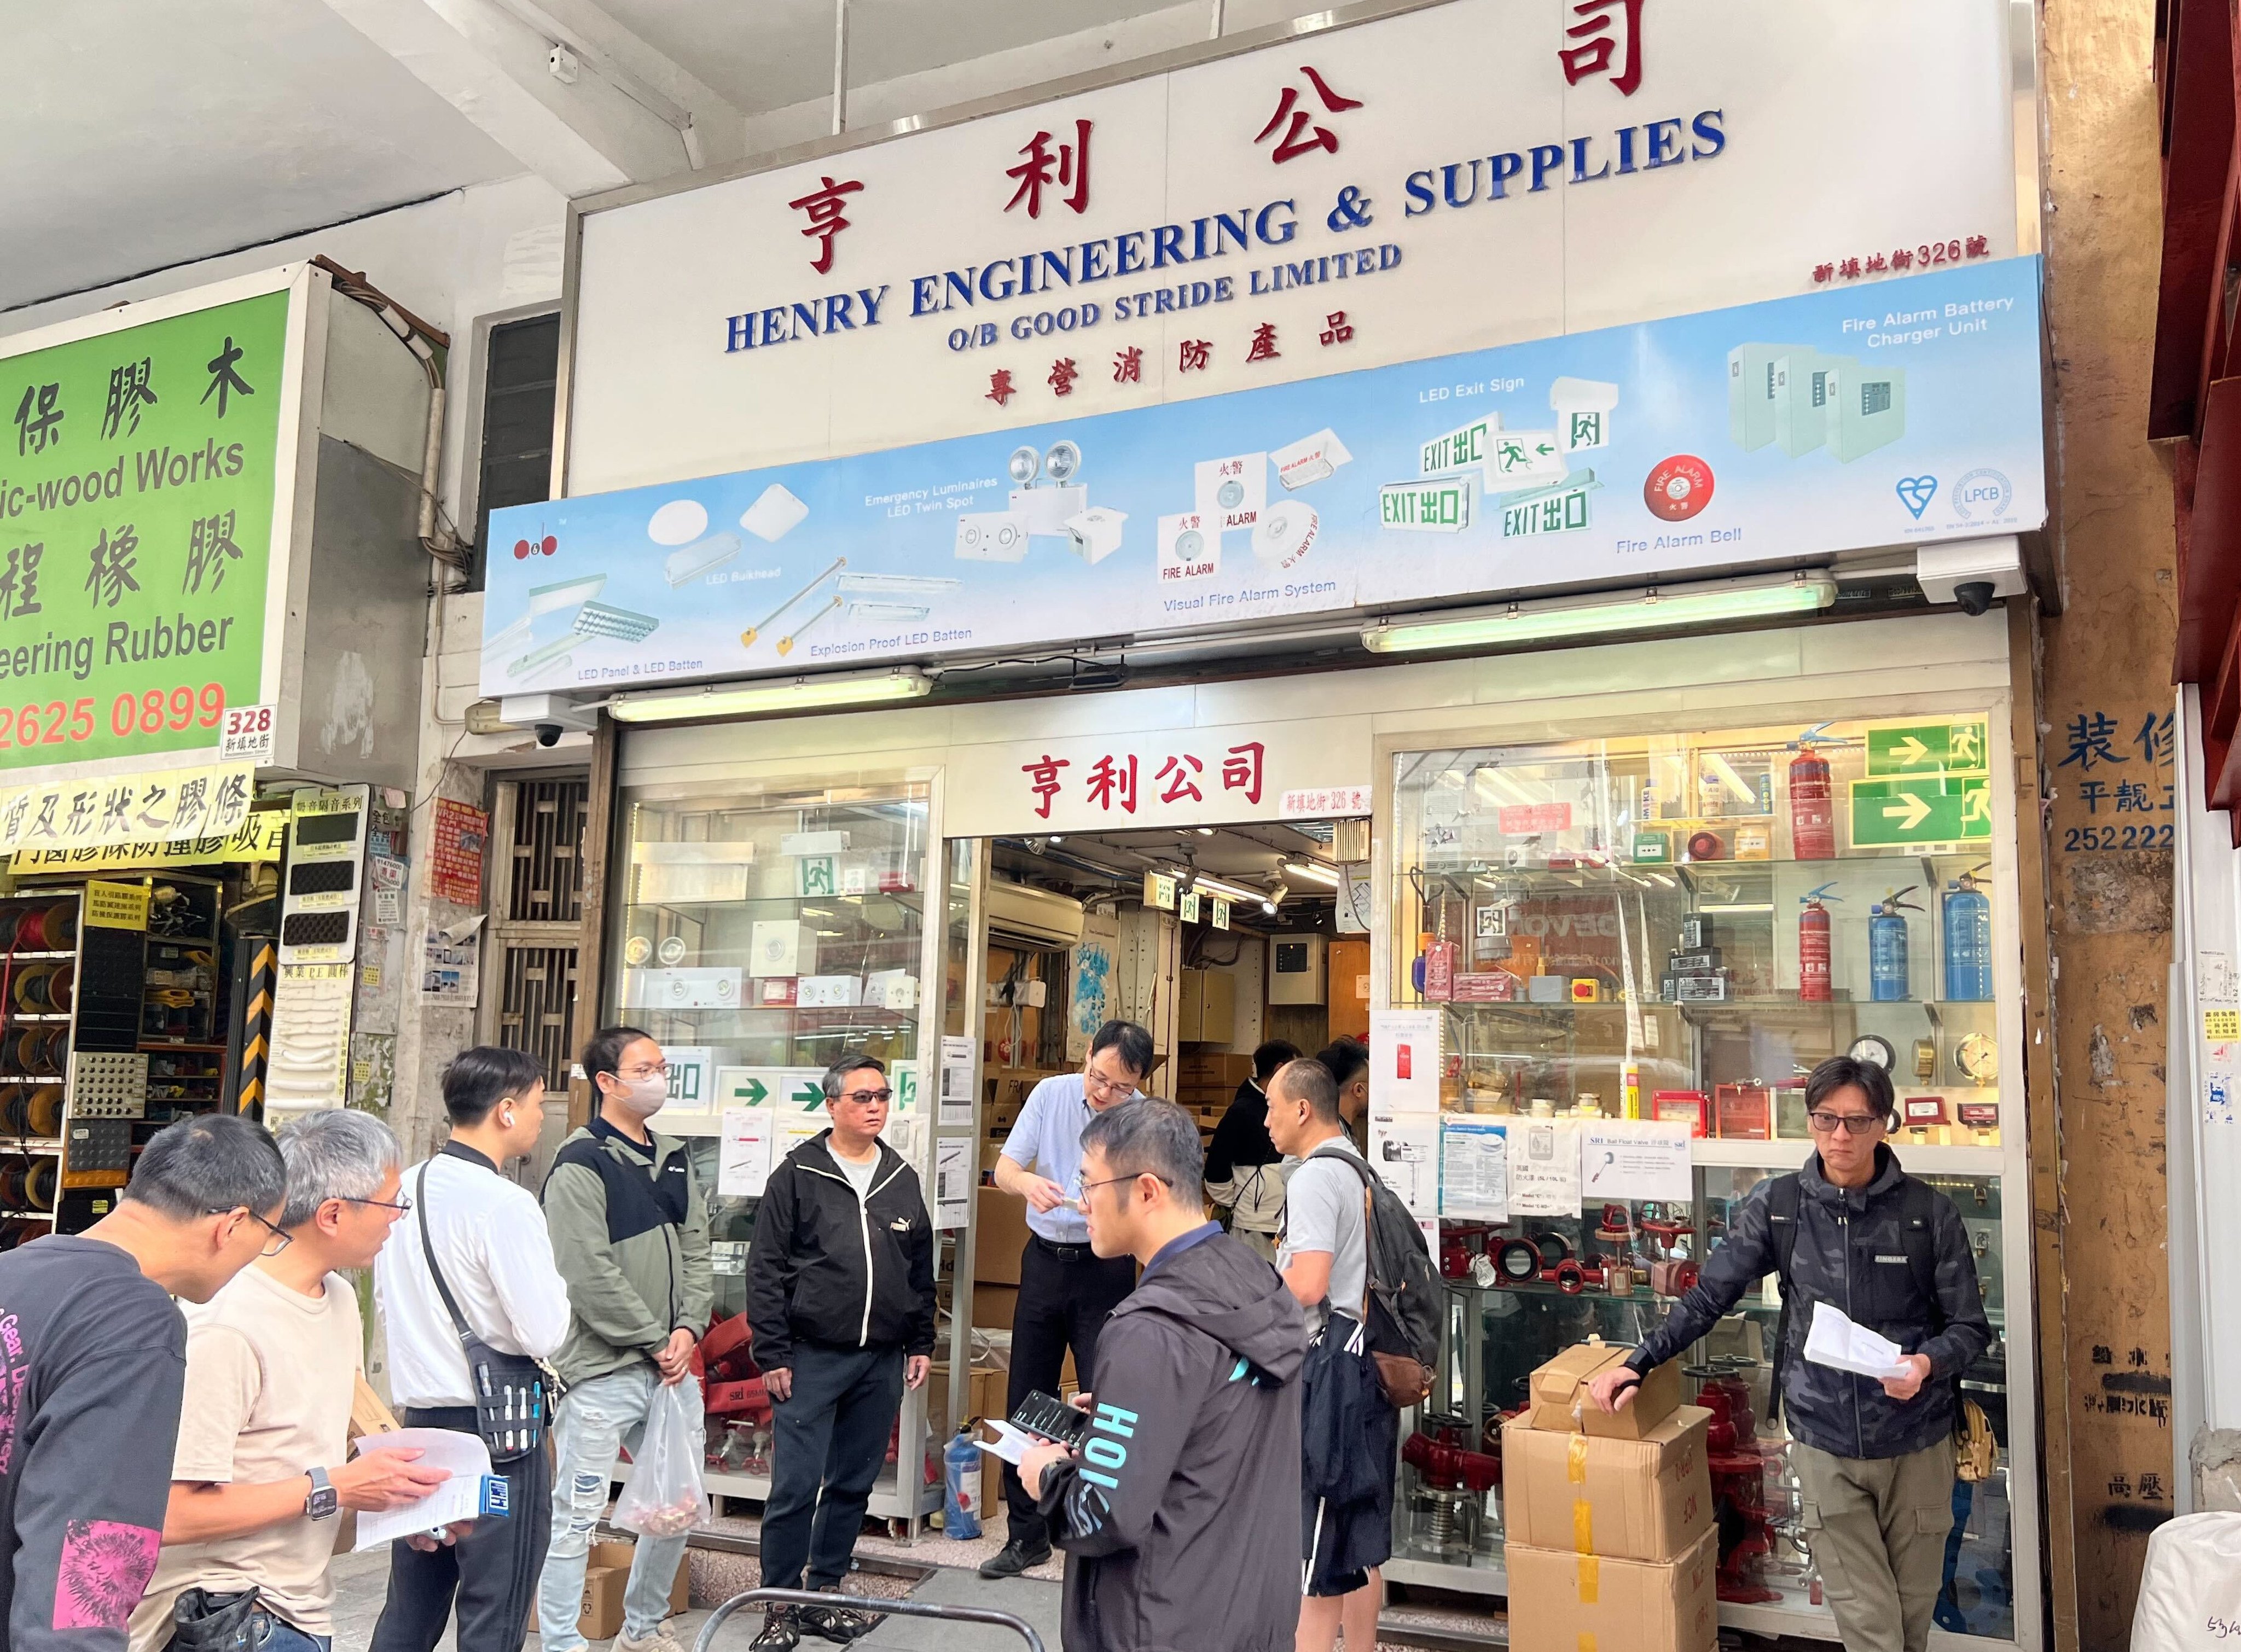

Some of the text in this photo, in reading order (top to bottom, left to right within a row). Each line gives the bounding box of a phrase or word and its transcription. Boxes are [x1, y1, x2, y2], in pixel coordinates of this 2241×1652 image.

[725, 108, 1726, 354] HENRY ENGINEERING & SUPPLIES
[1812, 234, 1989, 283] 新填地街326號
[948, 243, 1402, 353] O/B GOOD STRIDE LIMITED
[1843, 297, 2014, 334] Fire Alarm Battery
[1867, 318, 1988, 348] Charger Unit
[985, 310, 1355, 408] 專營消防產品
[1419, 377, 1524, 404] LED Exit Sign
[136, 442, 245, 492] Works
[1219, 461, 1244, 477] 火警
[1280, 456, 1308, 474] FIRE ALARM
[1424, 438, 1451, 473] EXIT
[865, 476, 998, 508] Emergency Luminaires
[1653, 465, 1704, 492] FIRE ALARM
[887, 495, 975, 519] LED Twin Spot
[1381, 492, 1417, 523] EXIT
[1420, 489, 1459, 525] 出口
[1964, 486, 1999, 503] LPCB
[1178, 515, 1201, 531] 火警
[1226, 510, 1257, 528] ALARM
[1503, 503, 1540, 538] EXIT
[1542, 491, 1587, 532] 出口
[1295, 529, 1316, 558] ALARM
[1616, 527, 1741, 555] Fire Alarm Bell
[705, 566, 782, 586] LED Bulkhead
[1162, 562, 1215, 580] FIRE ALARM
[1163, 580, 1337, 612] Visual Fire Alarm System
[104, 612, 234, 666] Rubber
[810, 627, 973, 658] Explosion Proof LED Batten
[577, 656, 704, 682] LED Panel & LED Batten
[0, 682, 226, 750] 2625 0899
[227, 708, 271, 735] 328
[225, 733, 270, 752] 新填地街
[1021, 741, 1265, 819] 亨利公司
[1331, 790, 1346, 810] 326
